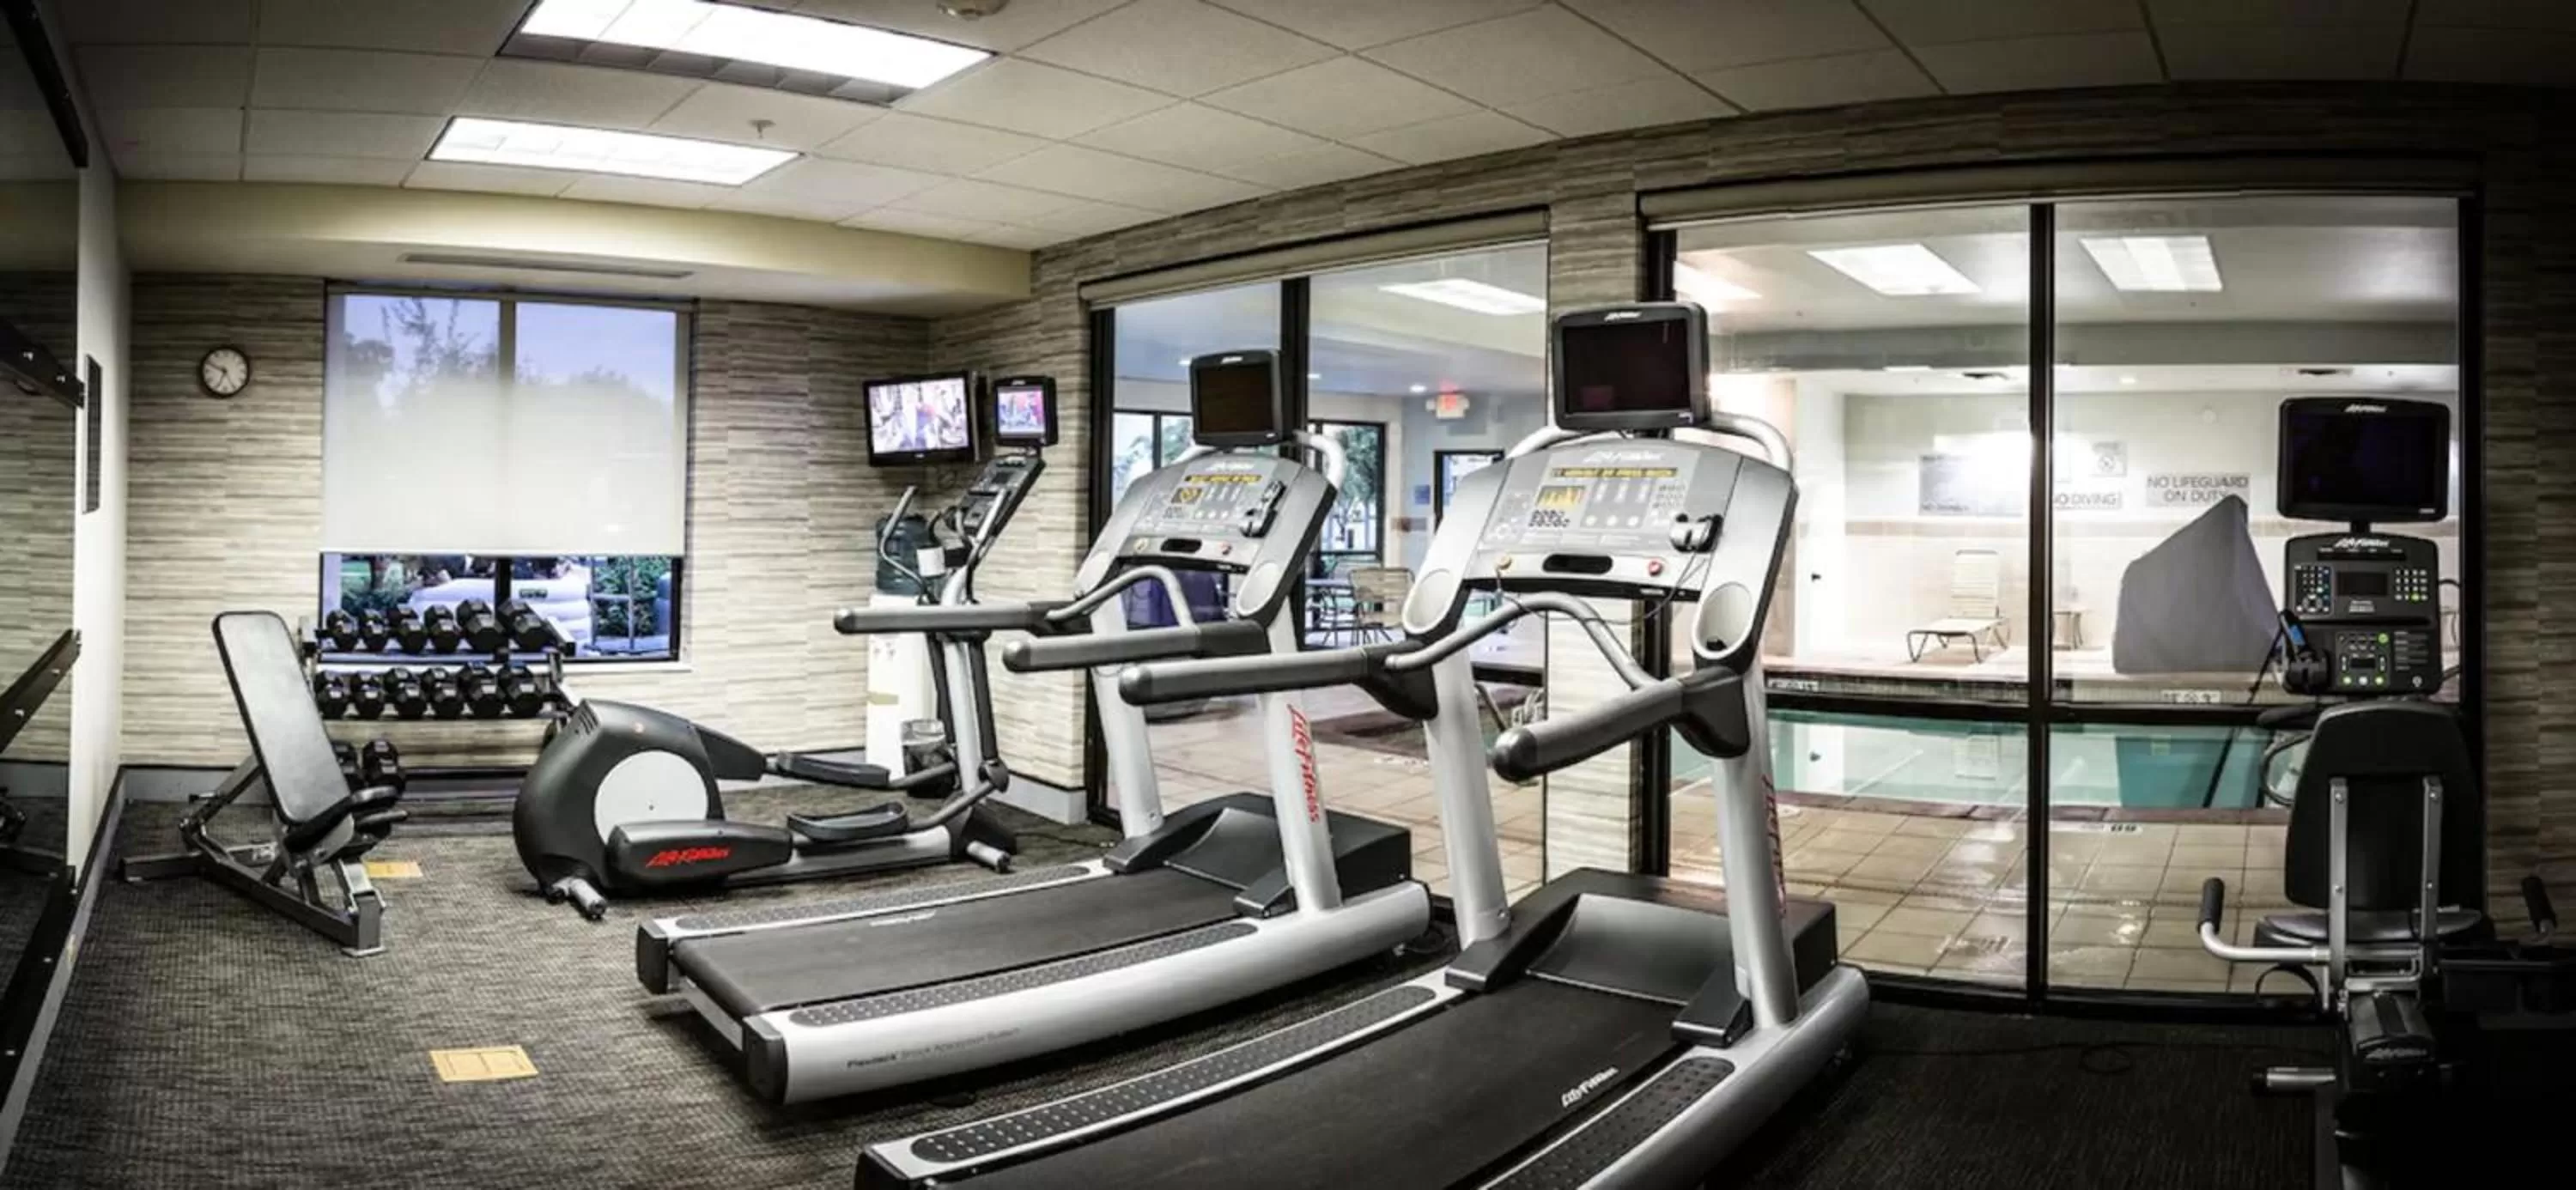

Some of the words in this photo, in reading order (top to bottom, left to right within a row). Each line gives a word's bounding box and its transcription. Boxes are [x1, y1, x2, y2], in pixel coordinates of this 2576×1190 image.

[2148, 476, 2170, 489] NO
[2172, 476, 2249, 489] LIFEGUARD
[2163, 489, 2186, 502] ON
